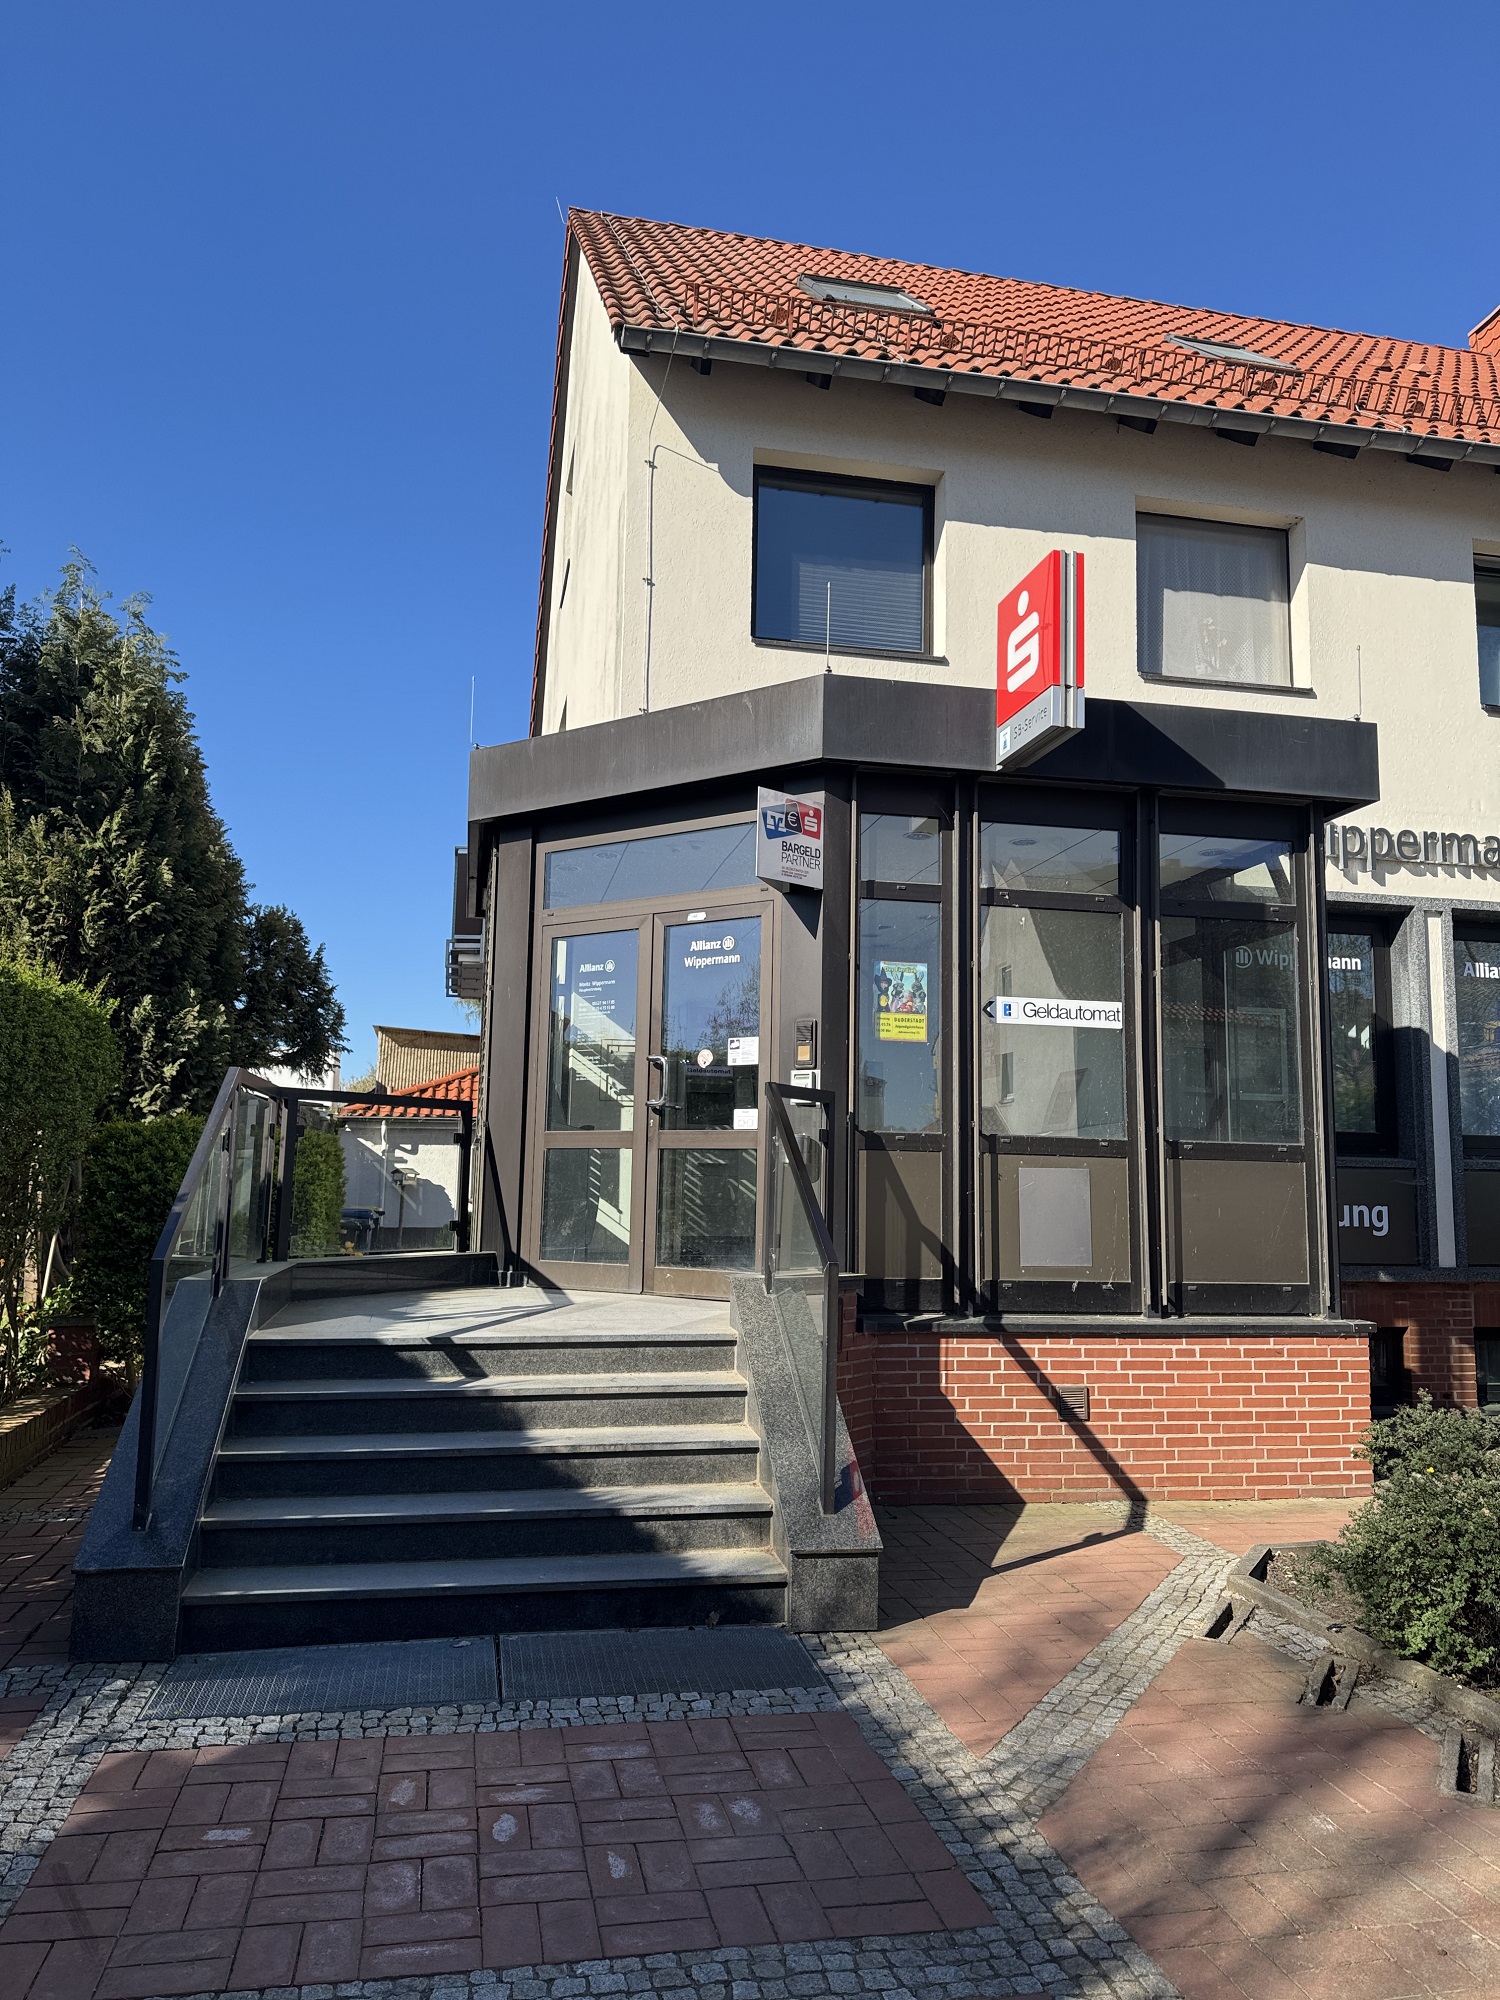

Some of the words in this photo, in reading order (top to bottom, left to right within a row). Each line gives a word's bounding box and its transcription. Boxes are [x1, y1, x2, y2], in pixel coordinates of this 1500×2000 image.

[1013, 707, 1047, 740] SB-Service
[781, 840, 821, 859] BARGELD
[781, 852, 821, 871] PARTNER
[690, 940, 722, 952] Allianz
[580, 963, 604, 973] Allianz
[684, 954, 741, 969] Wippermann
[1023, 1002, 1121, 1022] Geldautomat
[687, 1067, 732, 1075] Geldautomat
